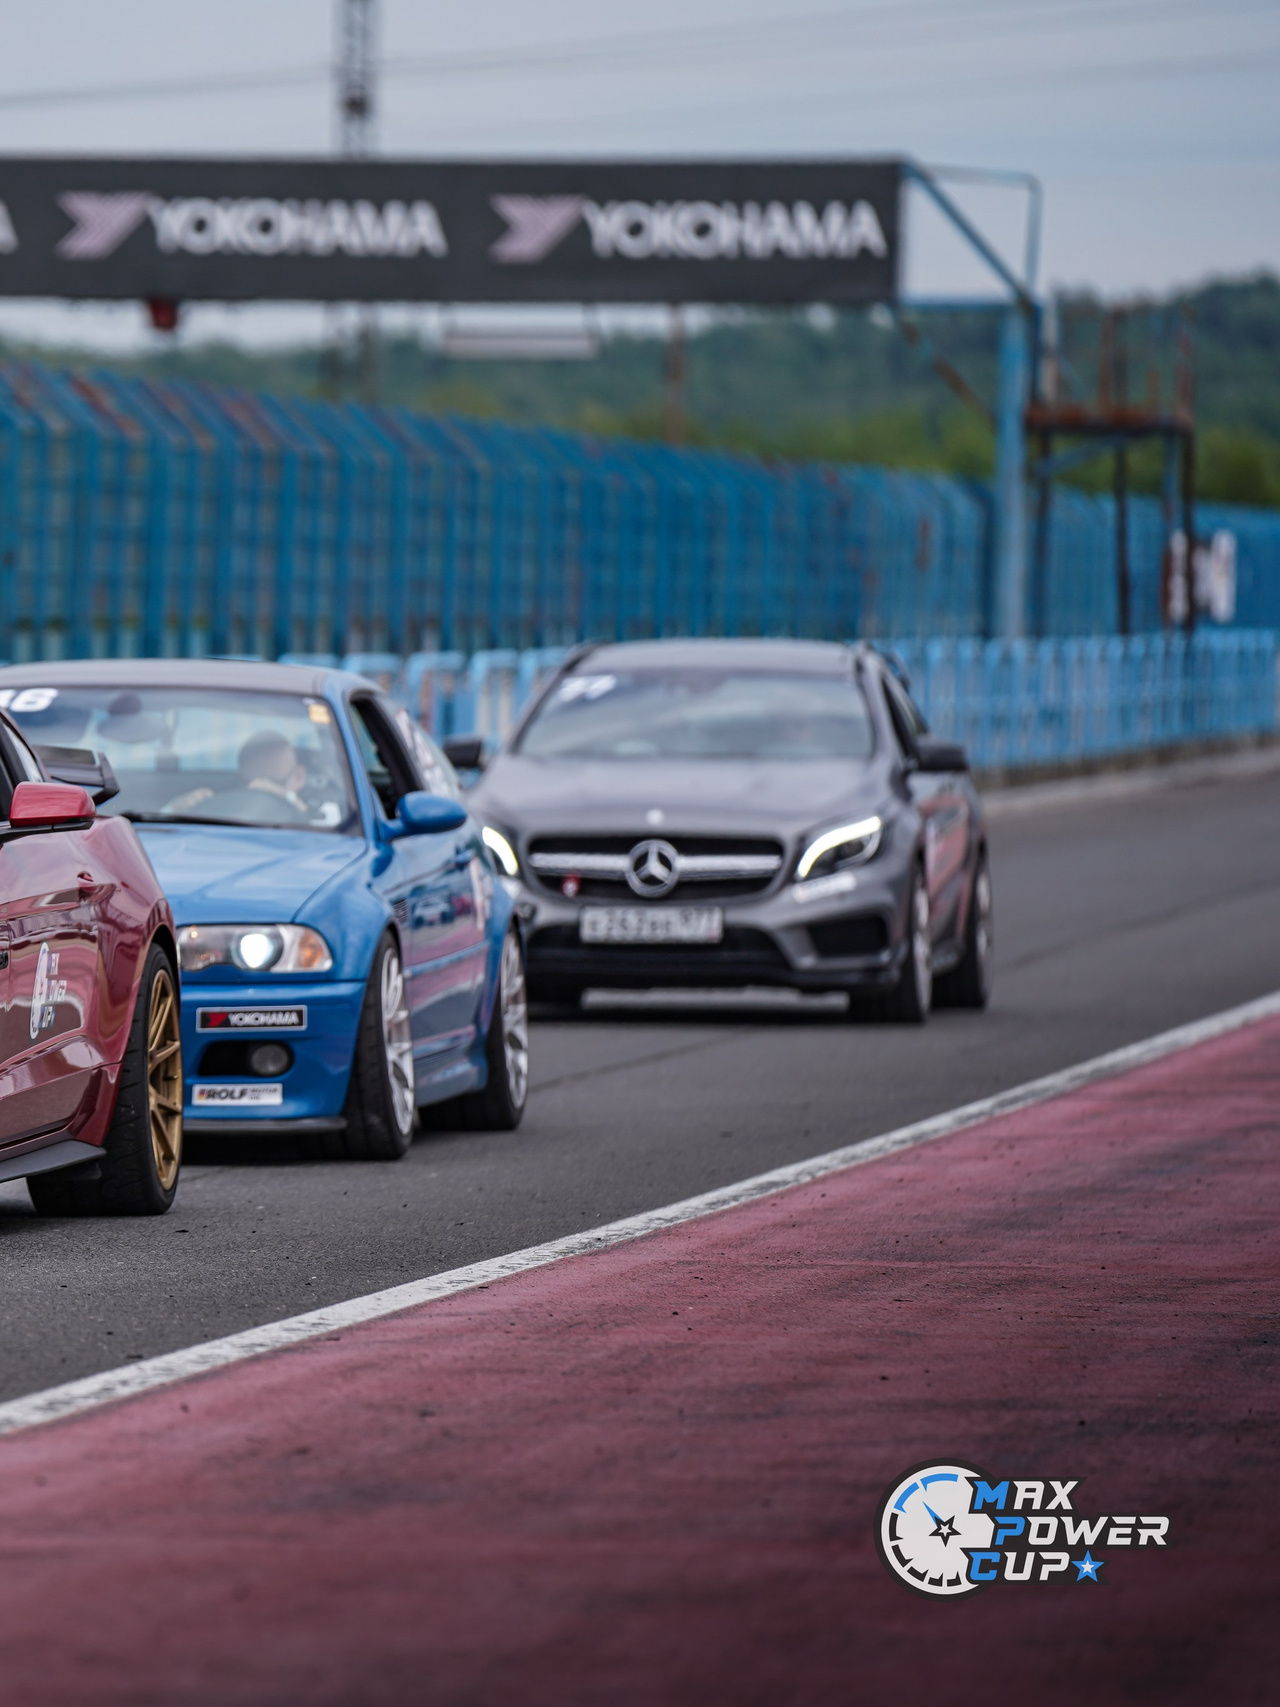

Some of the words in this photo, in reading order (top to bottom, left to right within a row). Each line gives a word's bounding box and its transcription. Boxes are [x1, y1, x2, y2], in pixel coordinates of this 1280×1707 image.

[149, 197, 448, 258] YOKOHAMA
[585, 198, 887, 260] YOKOHAMA
[228, 1010, 300, 1027] YOKOHAMA
[205, 1088, 248, 1100] ROLF
